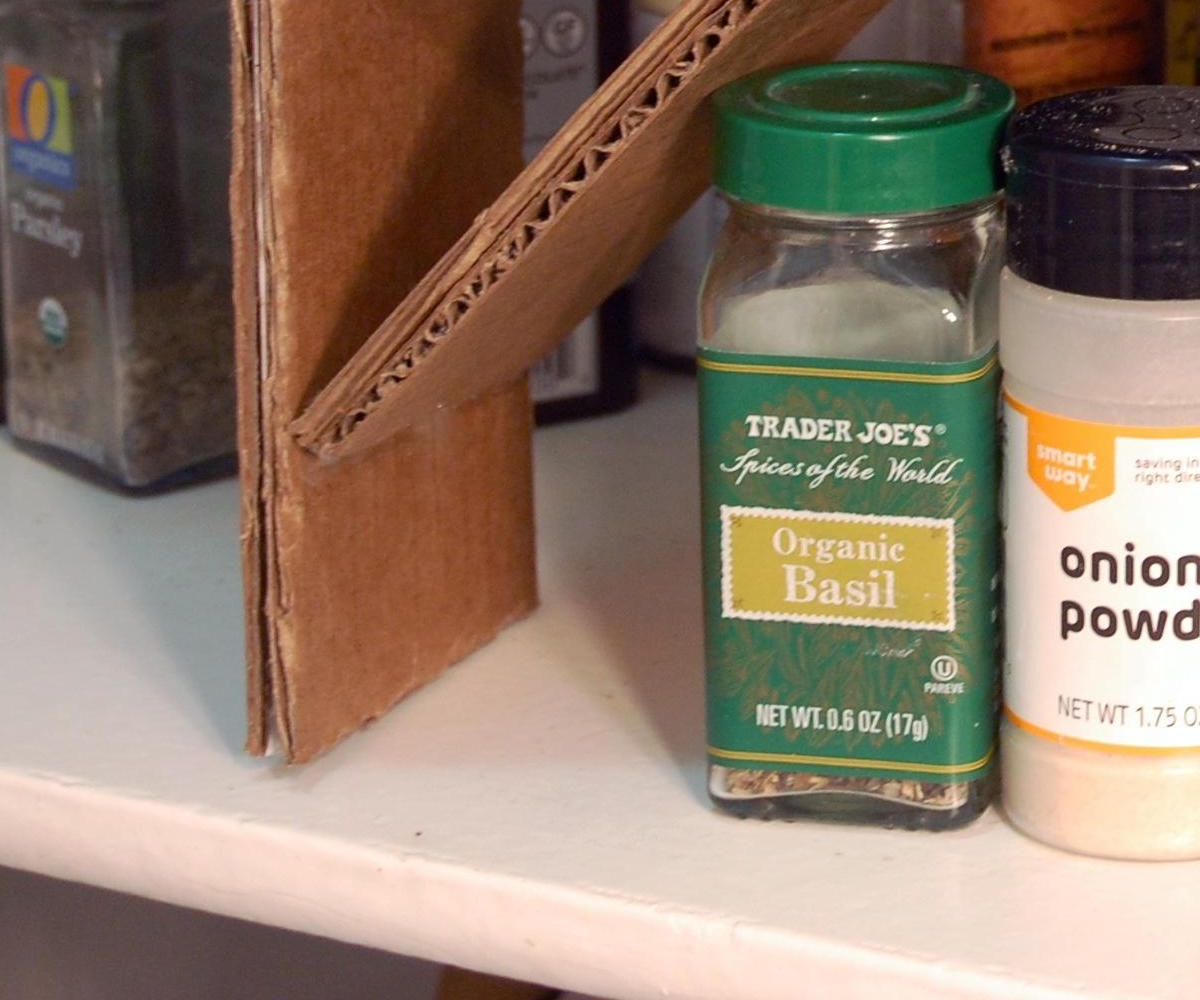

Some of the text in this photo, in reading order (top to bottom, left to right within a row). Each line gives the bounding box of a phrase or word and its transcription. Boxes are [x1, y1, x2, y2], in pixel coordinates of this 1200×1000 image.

[745, 414, 852, 443] TRADER
[720, 447, 964, 489] Spices of the World
[1037, 443, 1097, 470] smart
[1136, 457, 1181, 471] saving
[1186, 456, 1199, 468] in
[1044, 466, 1090, 492] way
[1135, 470, 1169, 485] right
[773, 527, 905, 564] Organic
[782, 563, 897, 610] Basil
[756, 704, 928, 742] NET WT. 0.6 OZ (17g)
[1058, 695, 1092, 721] NET
[1098, 703, 1128, 725] WT
[1137, 706, 1176, 728] 1.75
